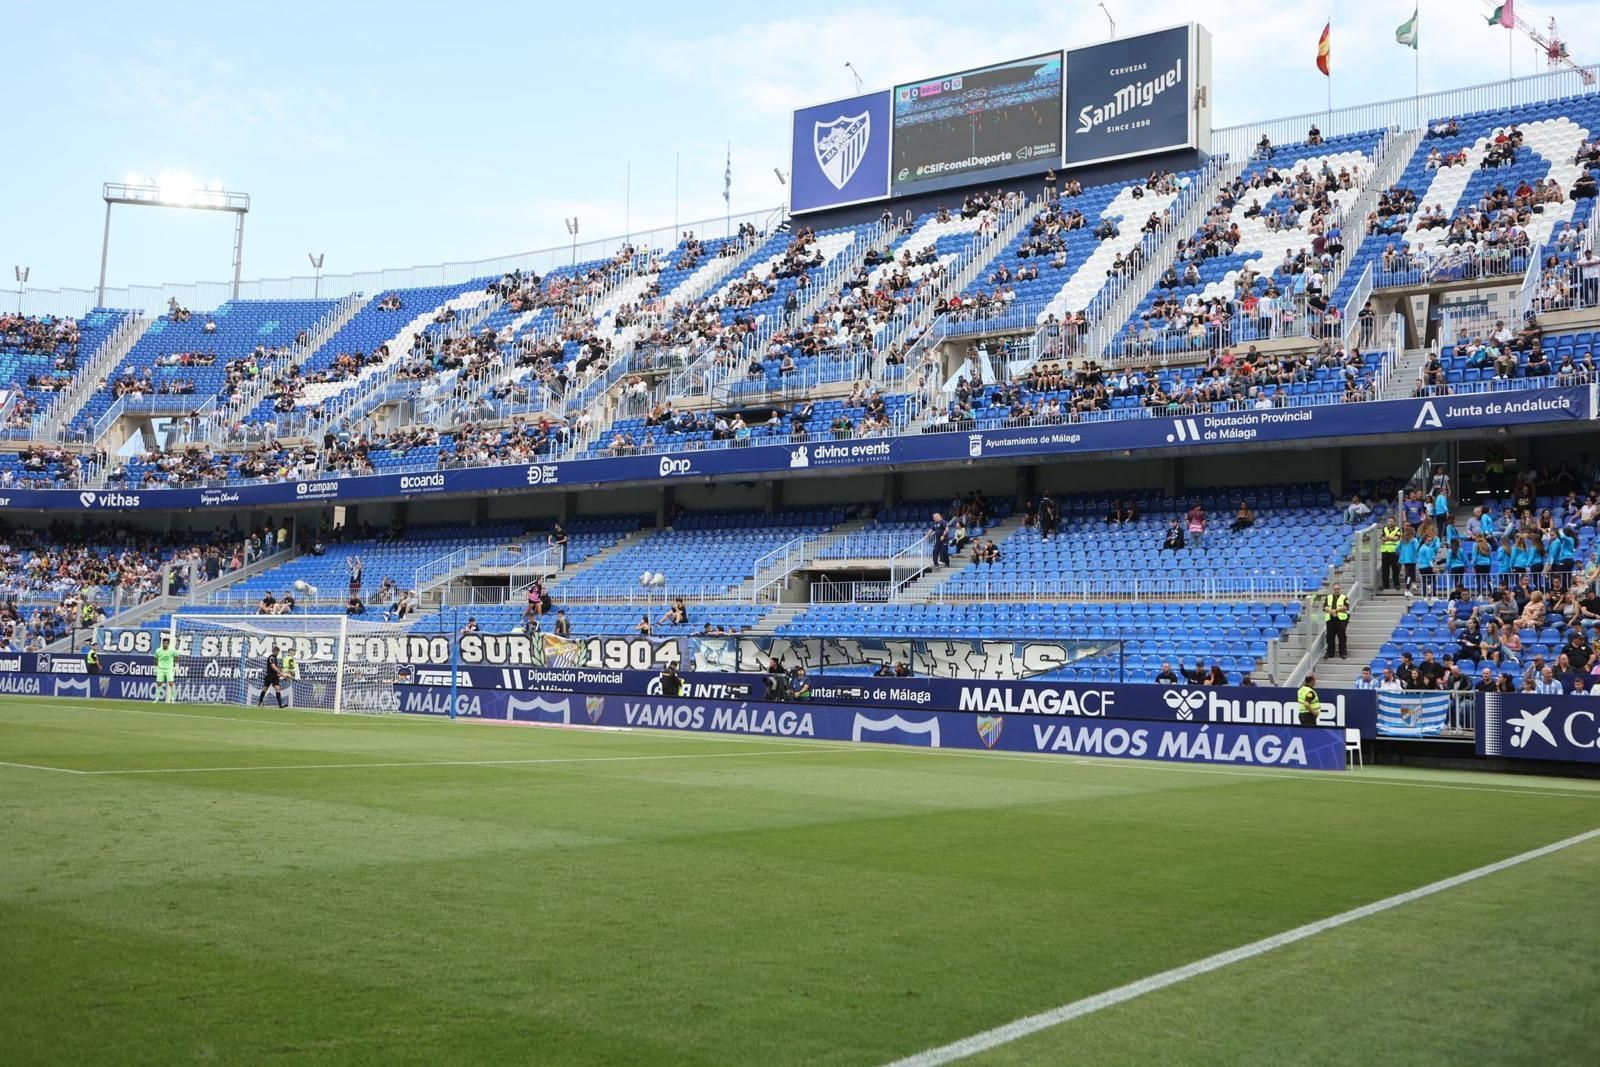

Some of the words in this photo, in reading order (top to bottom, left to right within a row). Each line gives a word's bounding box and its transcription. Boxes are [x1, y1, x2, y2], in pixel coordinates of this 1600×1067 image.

[1109, 62, 1148, 76] CERVEZAS
[1106, 124, 1129, 133] SINCE
[1131, 119, 1151, 129] 1890
[1446, 405, 1482, 418] Junta
[1484, 403, 1502, 415] de
[1504, 397, 1571, 414] Andalucía
[1204, 415, 1259, 428] Diputación
[1261, 410, 1312, 422] Provincial
[985, 436, 1038, 448] Ayuntamiento
[1040, 435, 1050, 444] de
[1051, 433, 1081, 445] Málaga
[1204, 429, 1217, 440] de
[1219, 427, 1257, 441] Málaga
[814, 445, 849, 459] divina
[852, 441, 890, 456] events
[309, 482, 339, 494] campano
[408, 473, 445, 488] coanda
[99, 493, 140, 507] vithas
[103, 631, 151, 653] LOS
[201, 636, 334, 660] SIEMPRE
[347, 636, 449, 664] FONDO
[460, 634, 532, 664] SUR
[586, 639, 681, 670] 1904
[305, 663, 341, 674] Diputació
[528, 669, 576, 684] Diputación
[577, 671, 623, 684] Provincial
[121, 680, 167, 700] VAMOS
[174, 679, 227, 702] MÁLAGA
[873, 688, 887, 700] de
[889, 687, 931, 703] Málaga
[343, 689, 402, 711] VAMOS
[405, 688, 482, 716] MÁLAGA
[624, 703, 705, 730] VAMOS
[710, 702, 815, 736] MÁLAGA
[1564, 711, 1600, 749] C
[1033, 724, 1149, 757] VAMOS
[1158, 724, 1307, 766] MÁLAGA
